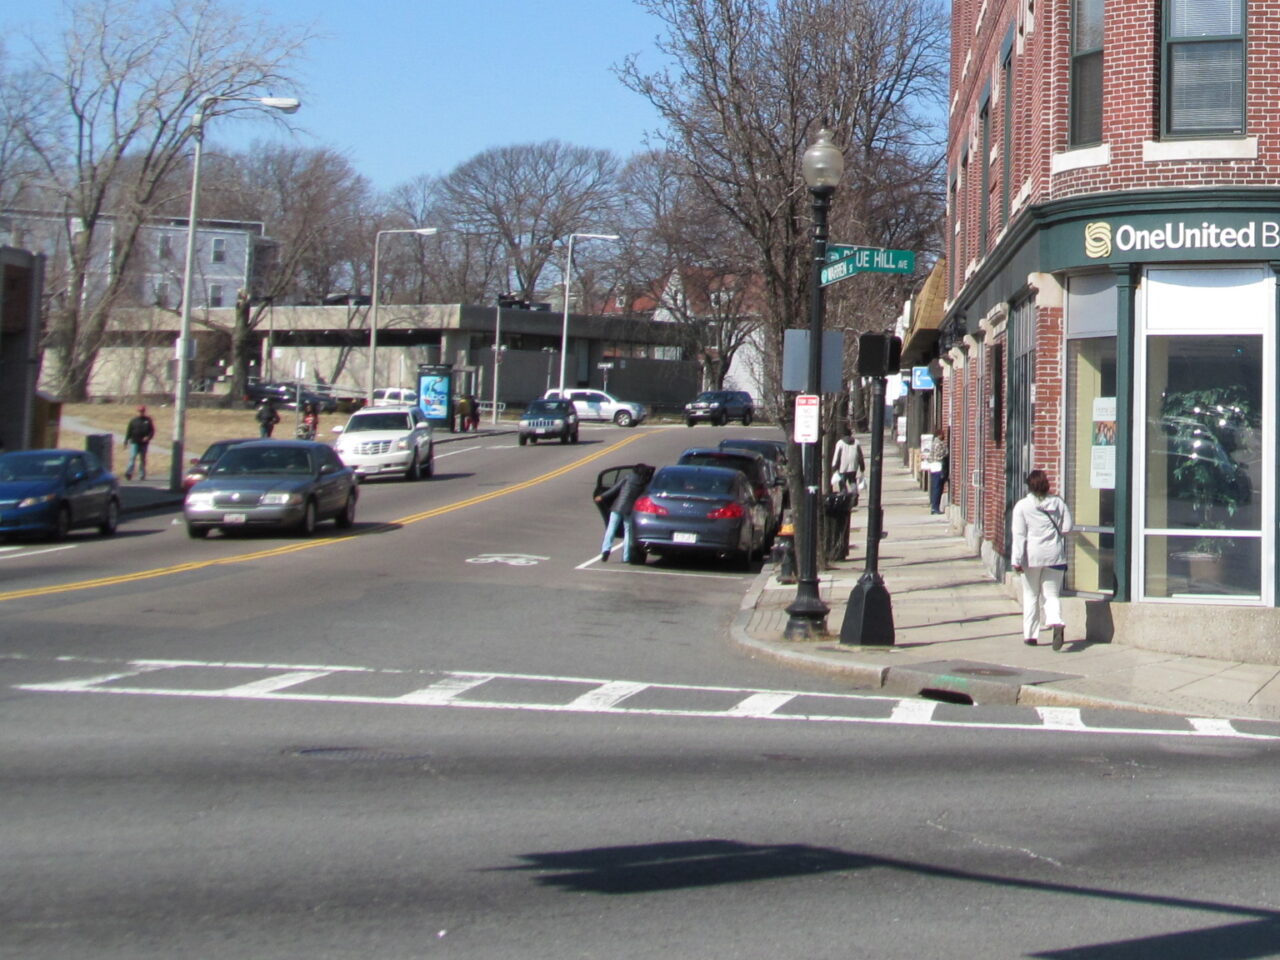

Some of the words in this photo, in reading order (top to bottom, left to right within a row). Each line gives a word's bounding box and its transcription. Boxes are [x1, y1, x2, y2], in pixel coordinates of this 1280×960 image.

[1116, 221, 1256, 251] OneUnited
[843, 249, 870, 268] BUE
[873, 252, 896, 269] HILL
[897, 260, 908, 269] AVE
[827, 261, 847, 280] WARREN
